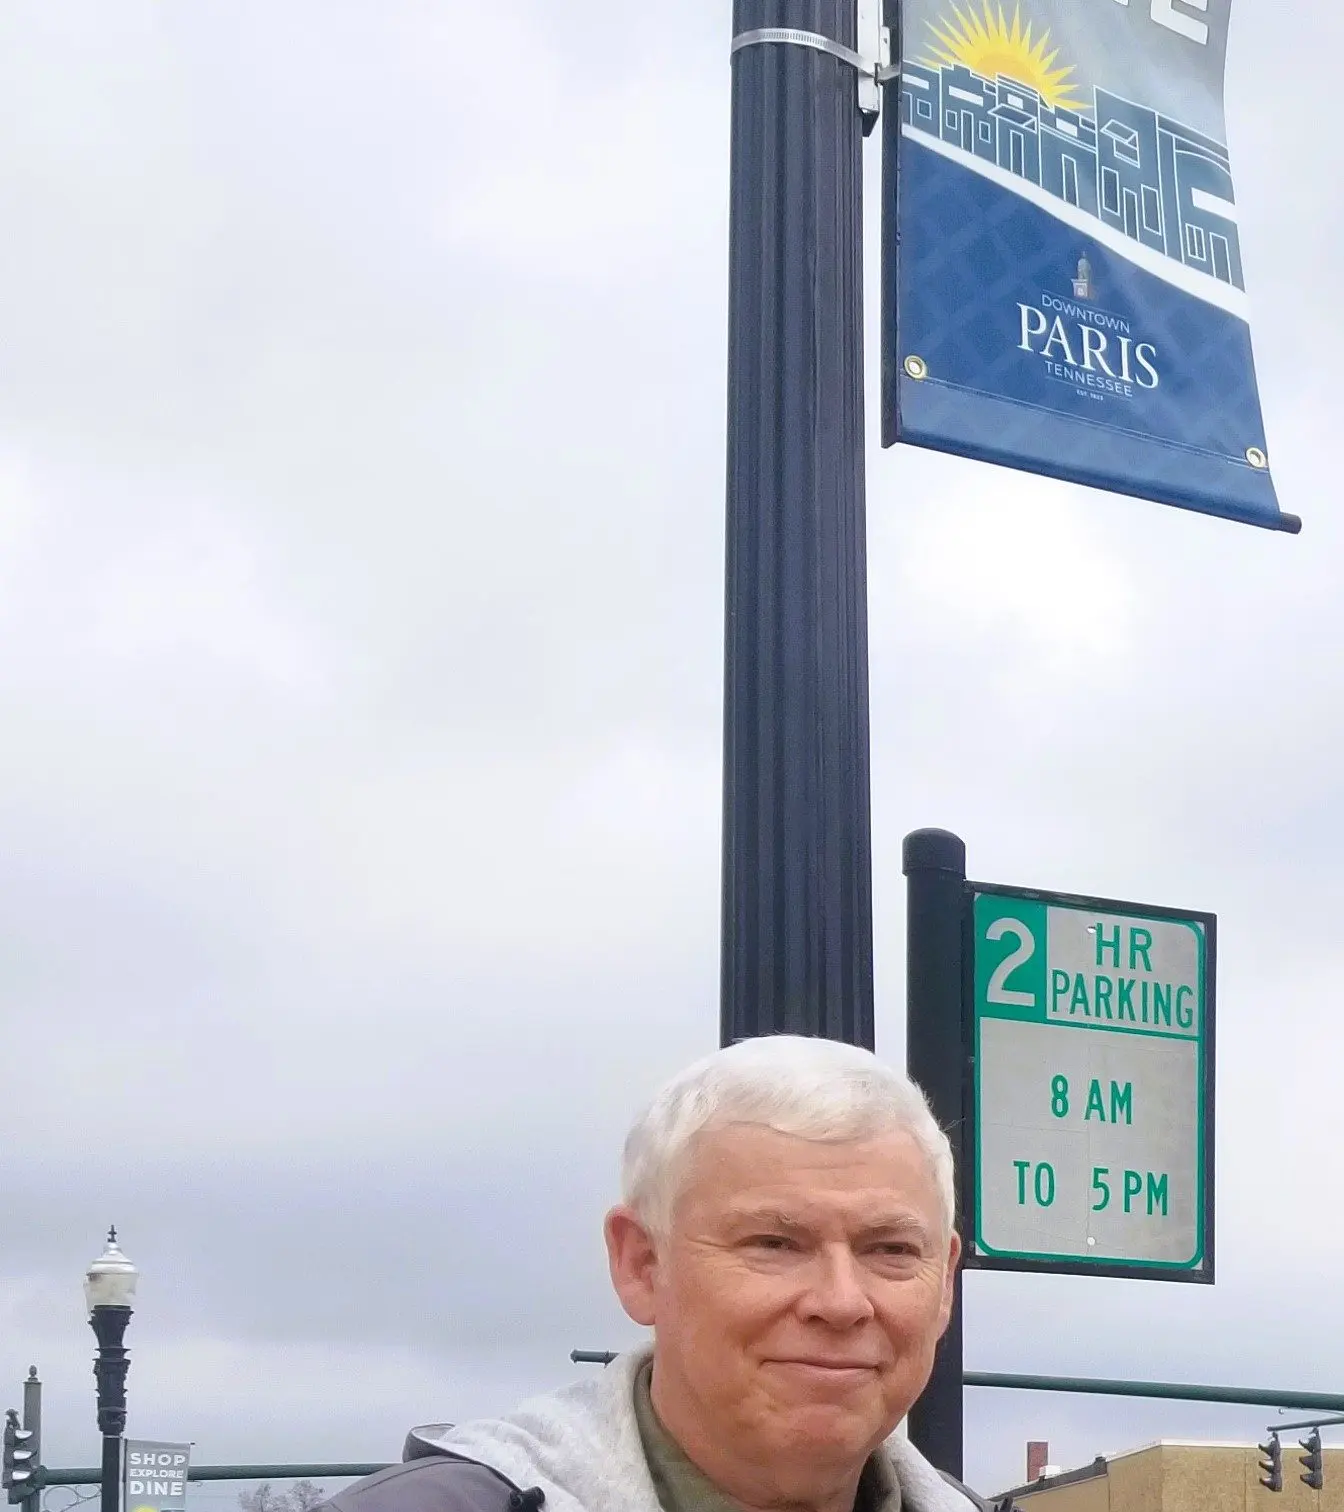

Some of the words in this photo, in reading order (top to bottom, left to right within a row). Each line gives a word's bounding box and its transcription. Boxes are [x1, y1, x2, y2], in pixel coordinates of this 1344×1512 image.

[1042, 294, 1130, 334] DOWNTOWN
[1016, 302, 1159, 389] PARIS
[1045, 360, 1133, 398] TENNESSEE
[985, 917, 1036, 1008] 2
[1095, 922, 1153, 973] HR
[1051, 970, 1194, 1029] PARKING
[1050, 1074, 1069, 1119] 8
[1084, 1079, 1133, 1125] AM
[1013, 1160, 1056, 1207] TO
[1092, 1167, 1110, 1211] 5
[1123, 1170, 1169, 1217] PM
[129, 1468, 184, 1479] EXPLORE
[130, 1452, 186, 1466] SHOP
[129, 1480, 184, 1496] DINE
